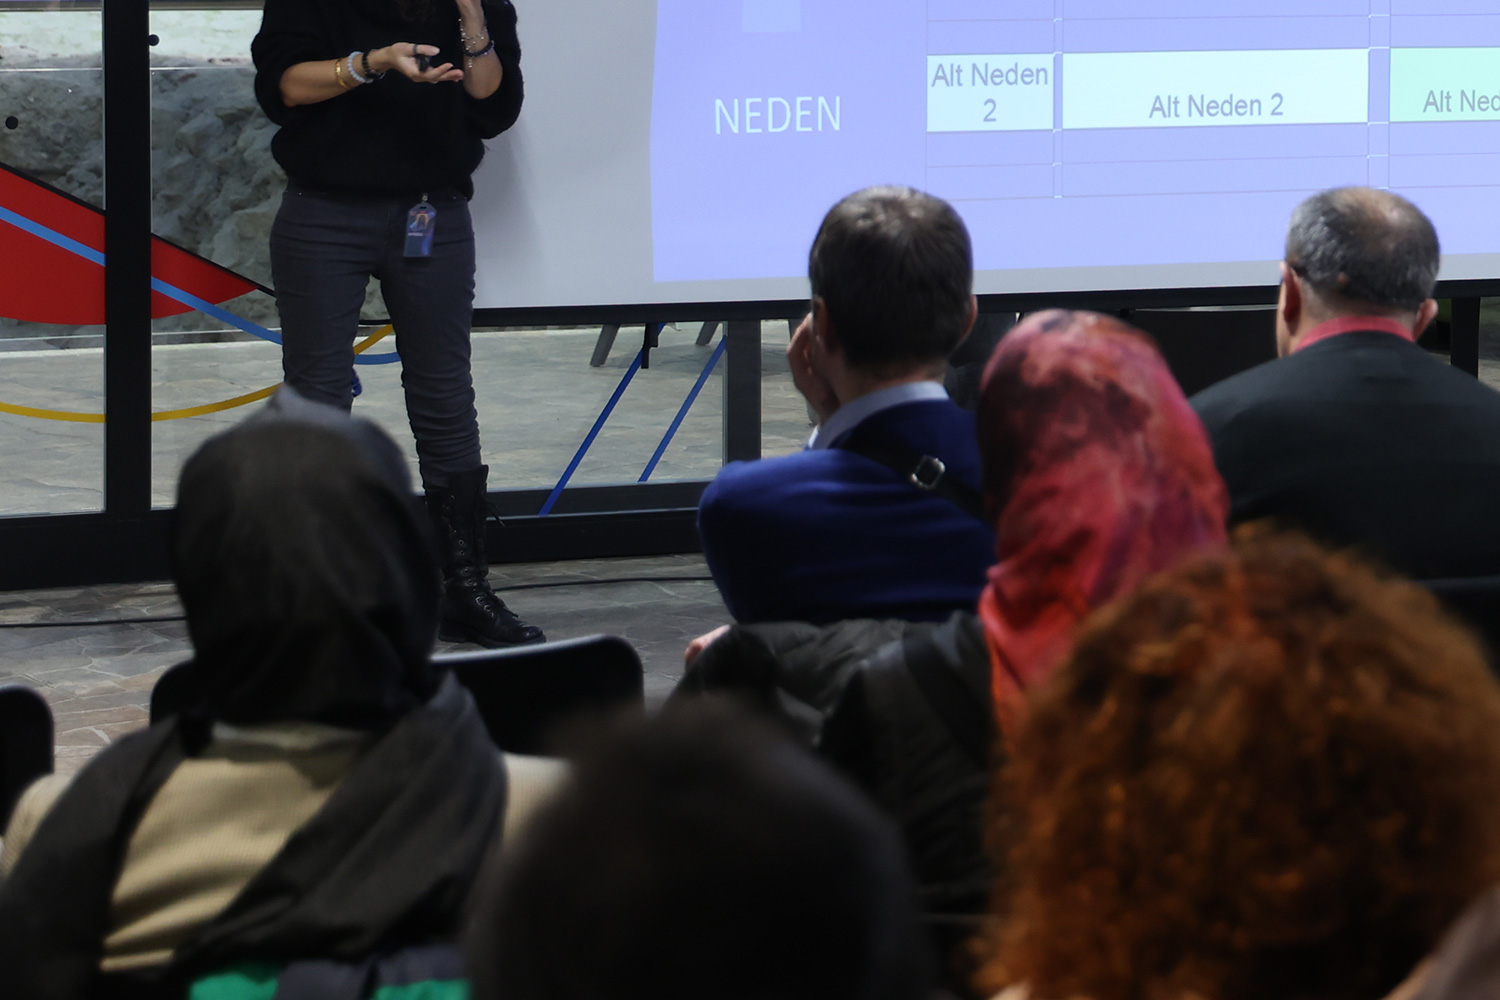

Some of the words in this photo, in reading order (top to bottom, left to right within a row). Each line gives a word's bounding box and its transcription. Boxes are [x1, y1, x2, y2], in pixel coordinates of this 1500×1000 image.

[931, 63, 963, 88] Alt
[971, 62, 1048, 87] Neden
[982, 98, 997, 123] 2
[1148, 94, 1181, 119] Alt
[1189, 93, 1262, 118] Neden
[1270, 92, 1284, 116] 2
[1422, 89, 1452, 113] Alt
[714, 95, 842, 135] NEDEN
